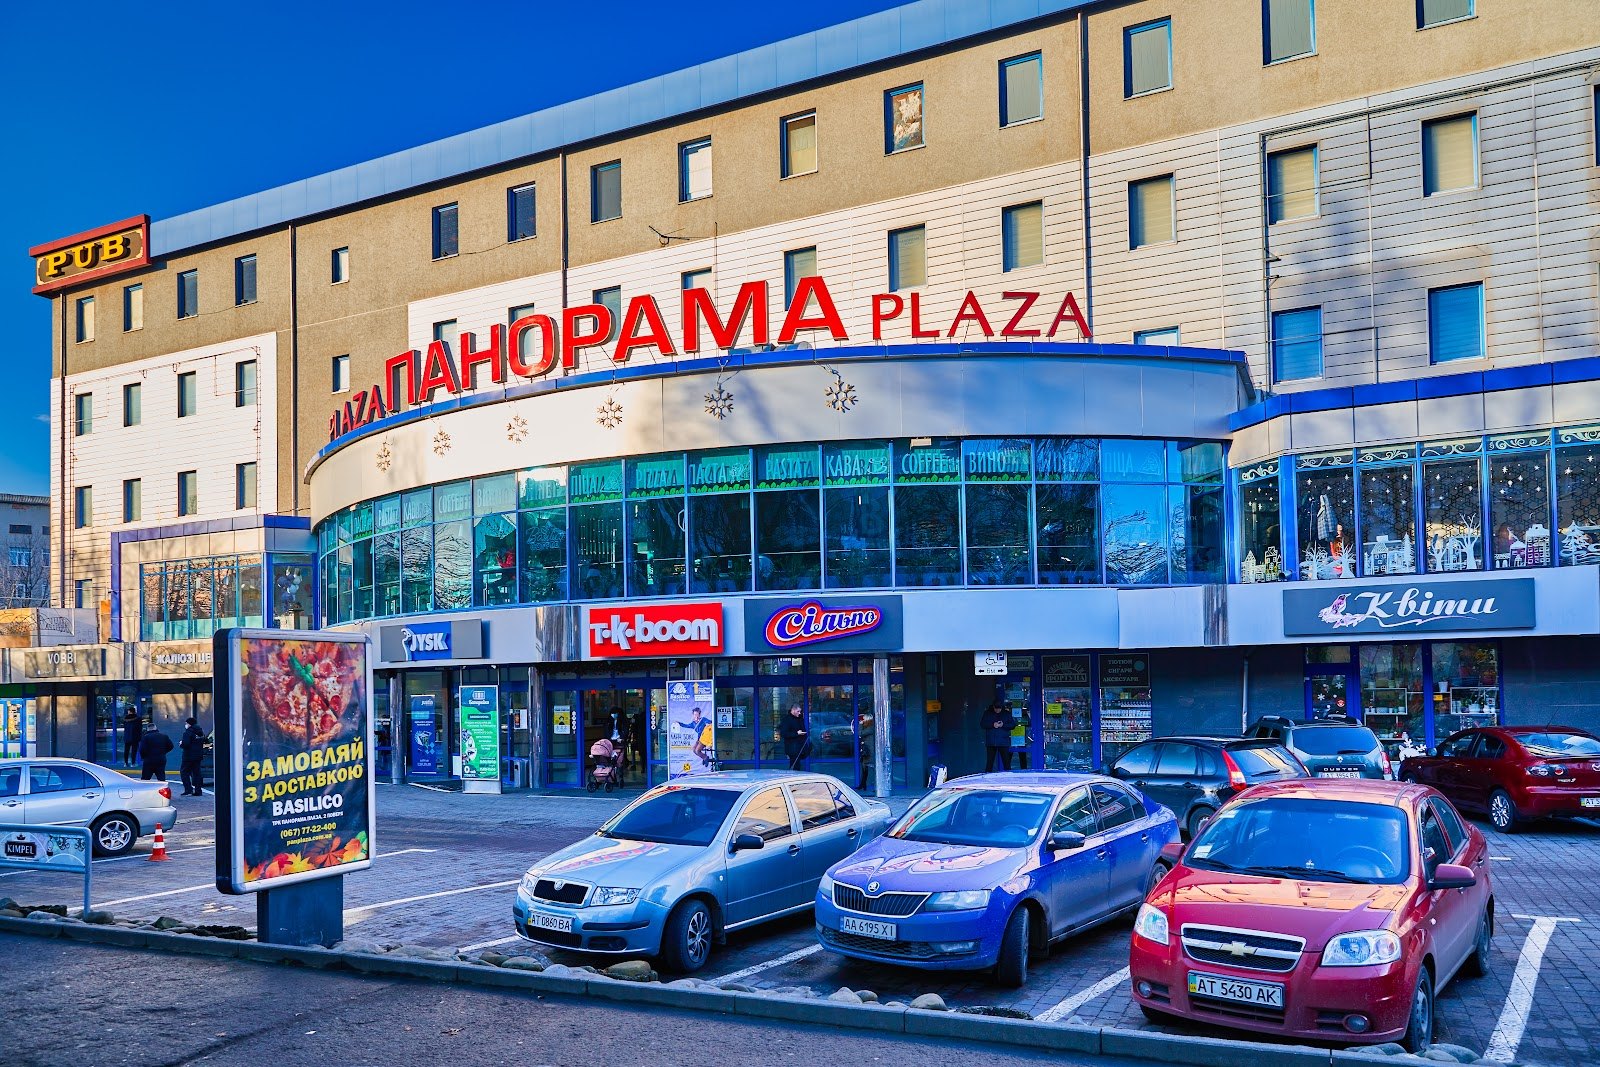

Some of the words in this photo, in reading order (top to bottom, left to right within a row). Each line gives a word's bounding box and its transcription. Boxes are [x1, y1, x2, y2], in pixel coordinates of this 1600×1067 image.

[45, 234, 127, 277] PUB
[872, 290, 1093, 341] PLAZA
[385, 275, 848, 412] ПАНОРАМА
[688, 461, 727, 485] ПАСТА
[826, 454, 861, 477] КАВА
[902, 453, 947, 474] COFFEE
[1355, 587, 1499, 619] Квіти
[776, 606, 878, 640] Сільпо
[409, 632, 449, 652] JYSK
[156, 653, 195, 665] ЖАЛЮЗІ
[1047, 674, 1085, 682] ФОРТУНА
[245, 736, 364, 782] ЗАМОВЛЯЙ
[244, 786, 258, 803] З
[261, 764, 364, 803] ДОСТАВКОЮ
[272, 793, 344, 817] BASILICO
[280, 827, 301, 839] (067)
[301, 822, 337, 834] 77-22-400
[7, 844, 35, 855] KIMPEL
[531, 914, 541, 925] AT
[558, 919, 570, 931] BA
[844, 918, 857, 931] AA
[858, 921, 879, 934] 6195
[1197, 978, 1217, 994] AT
[1220, 982, 1252, 1000] 5430
[1256, 988, 1277, 1004] AK
